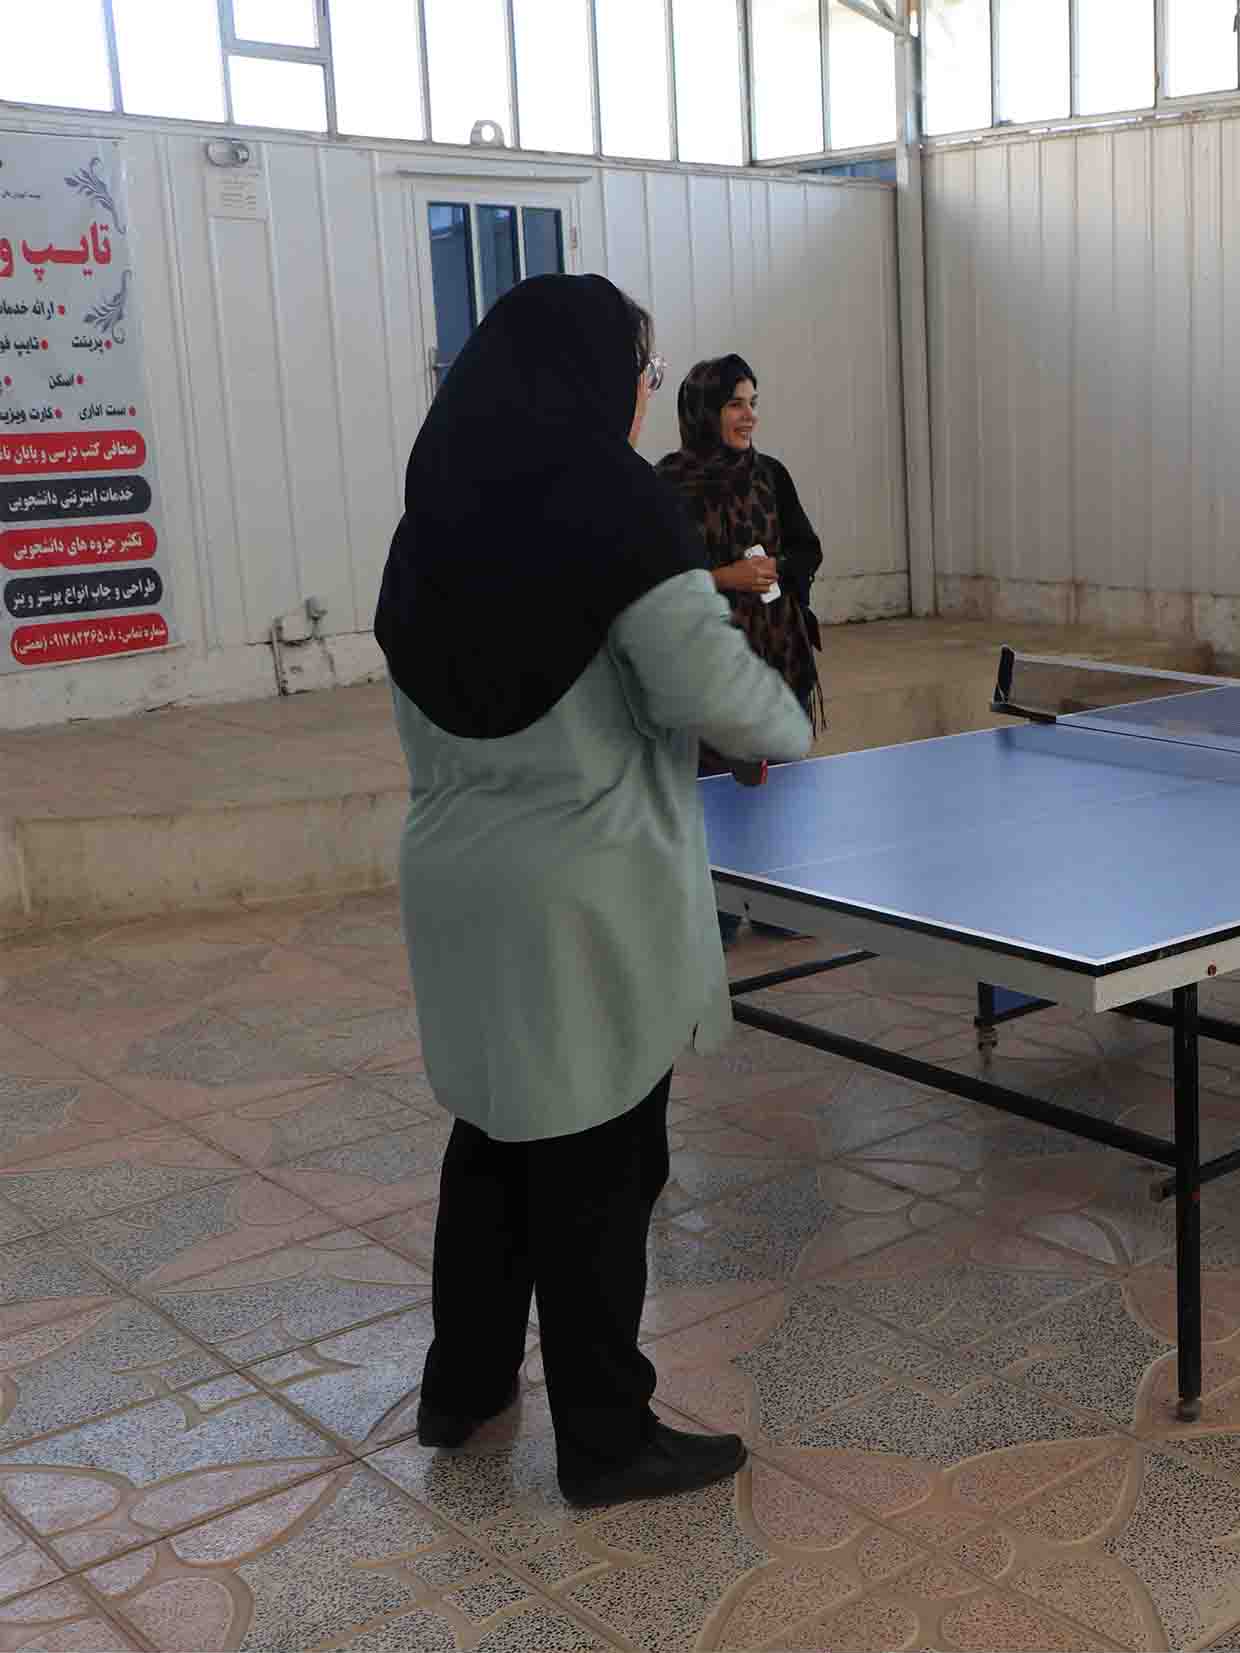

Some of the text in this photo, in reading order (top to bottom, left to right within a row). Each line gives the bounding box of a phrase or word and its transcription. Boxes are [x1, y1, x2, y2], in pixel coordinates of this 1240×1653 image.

[21, 222, 112, 282] تایپ
[13, 336, 40, 357] تایپ
[71, 335, 104, 354] پرینت
[48, 373, 75, 389] اسکن
[29, 406, 53, 423] کارت
[79, 403, 102, 421] اداری
[48, 446, 78, 463] درسی
[80, 440, 100, 461] کتب
[103, 439, 137, 461] صحافی
[8, 486, 134, 511] خدمات اینترنتی دانشجویی
[13, 538, 64, 560] دانشجویی
[120, 532, 143, 551] تکثیر
[65, 584, 89, 605] انواع
[114, 587, 120, 601] و
[122, 577, 156, 599] طراحی
[28, 595, 34, 609] و
